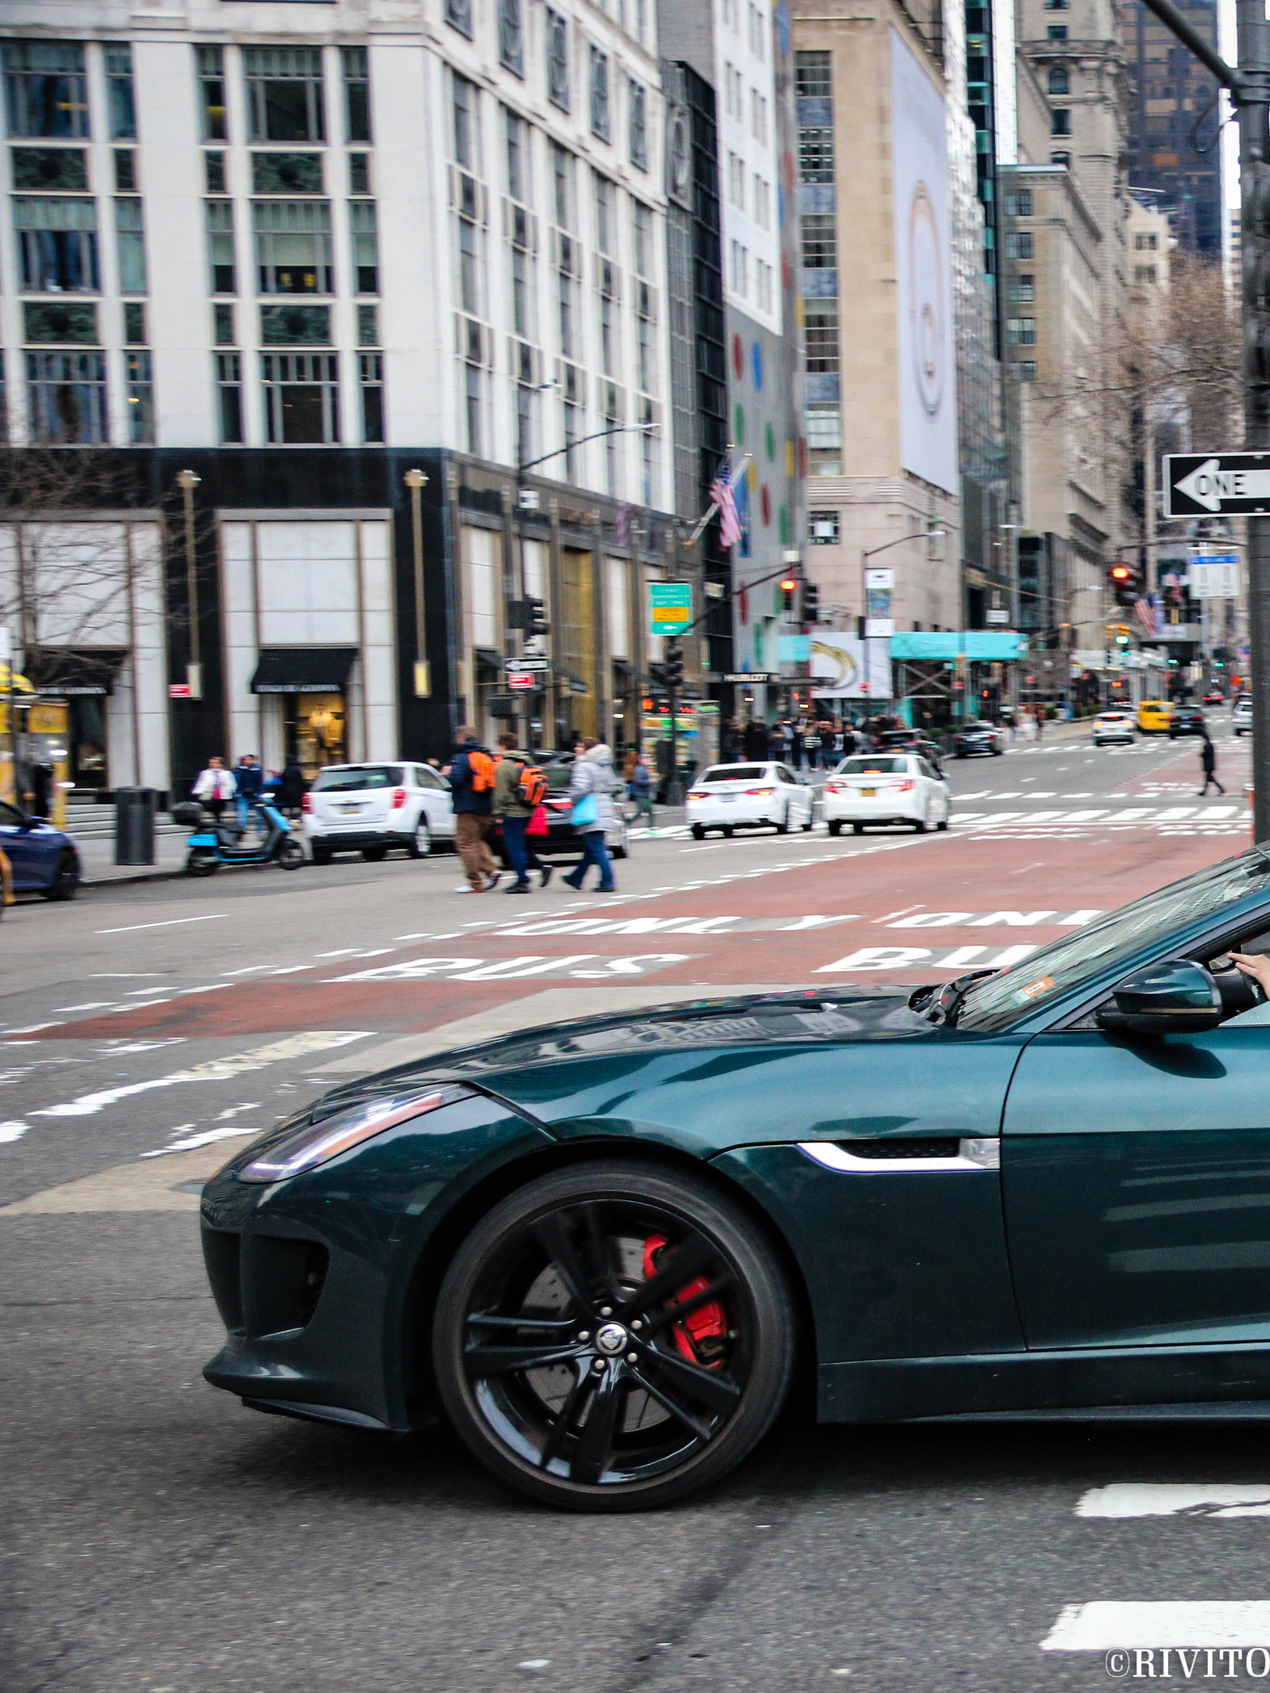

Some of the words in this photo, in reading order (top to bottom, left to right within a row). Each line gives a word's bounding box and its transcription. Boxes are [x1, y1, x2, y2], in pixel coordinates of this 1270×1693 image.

[1194, 473, 1248, 497] ONE
[493, 914, 867, 936] ONLY
[886, 909, 1104, 927] ONL
[317, 953, 692, 983] BUS
[810, 944, 1039, 974] BU
